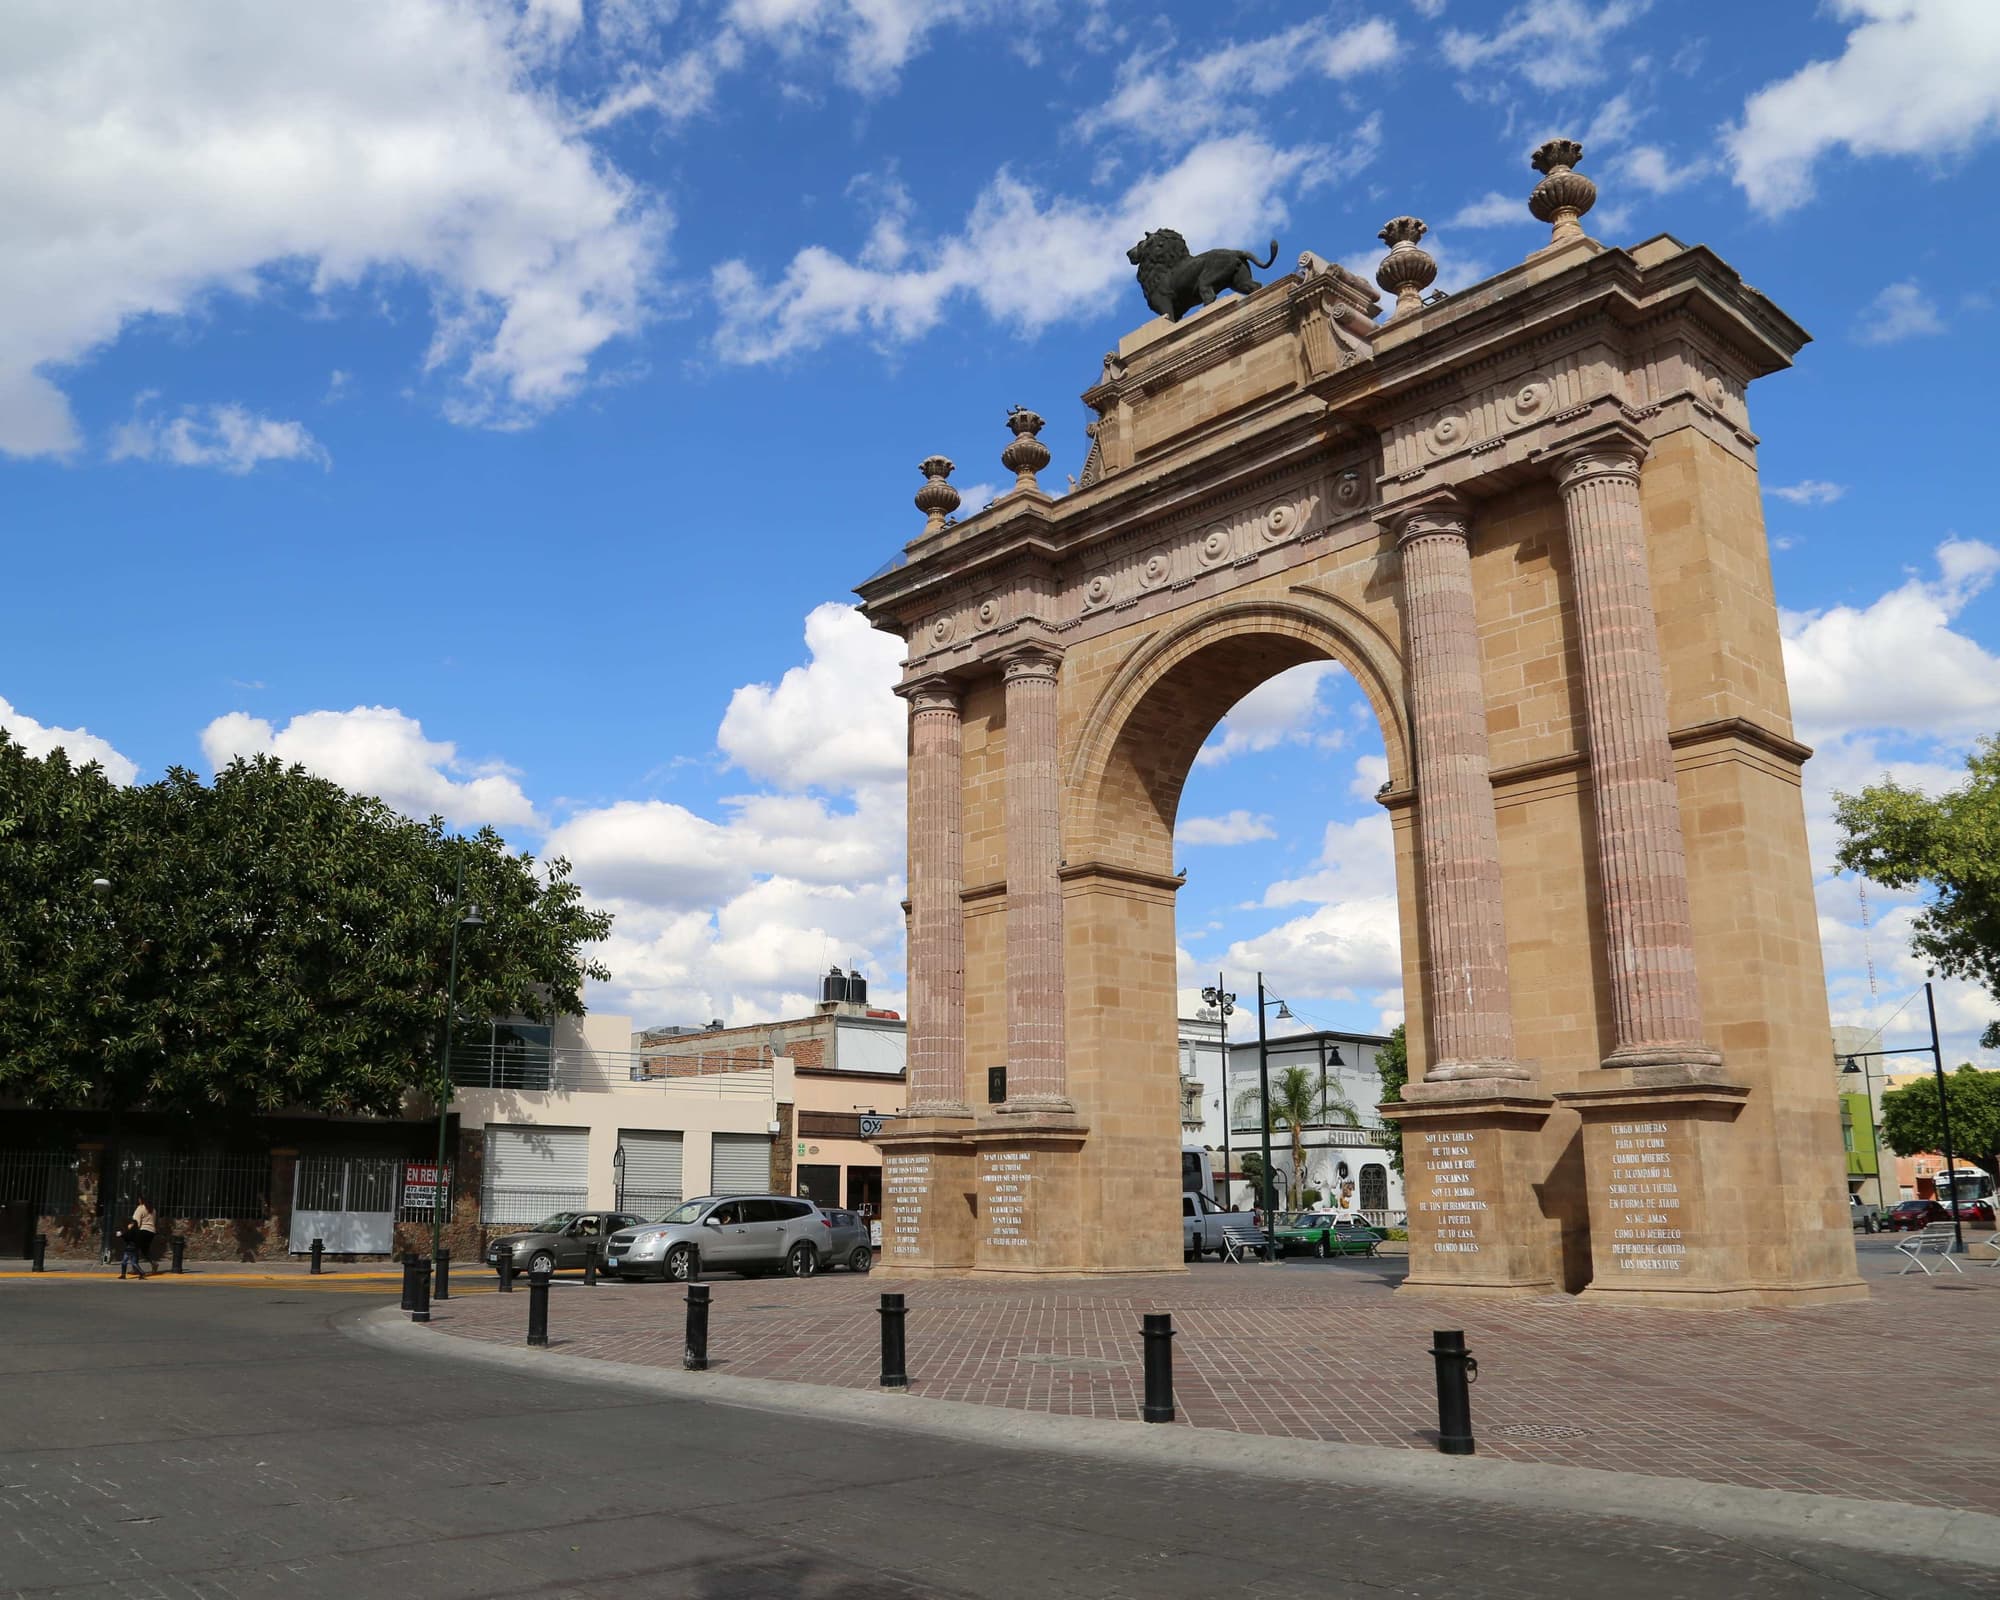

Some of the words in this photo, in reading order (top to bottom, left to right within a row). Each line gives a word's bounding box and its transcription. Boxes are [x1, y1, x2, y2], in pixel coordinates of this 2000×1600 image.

[1611, 1124, 1632, 1135] TENGO
[1634, 1123, 1668, 1134] MADERAS
[1616, 1139, 1632, 1149] PARA
[1634, 1138, 1644, 1148] TU
[1612, 1154, 1640, 1164] CUANDO
[1642, 1153, 1671, 1163] MUERES
[407, 1168, 418, 1182] EN
[421, 1168, 448, 1182] RENA
